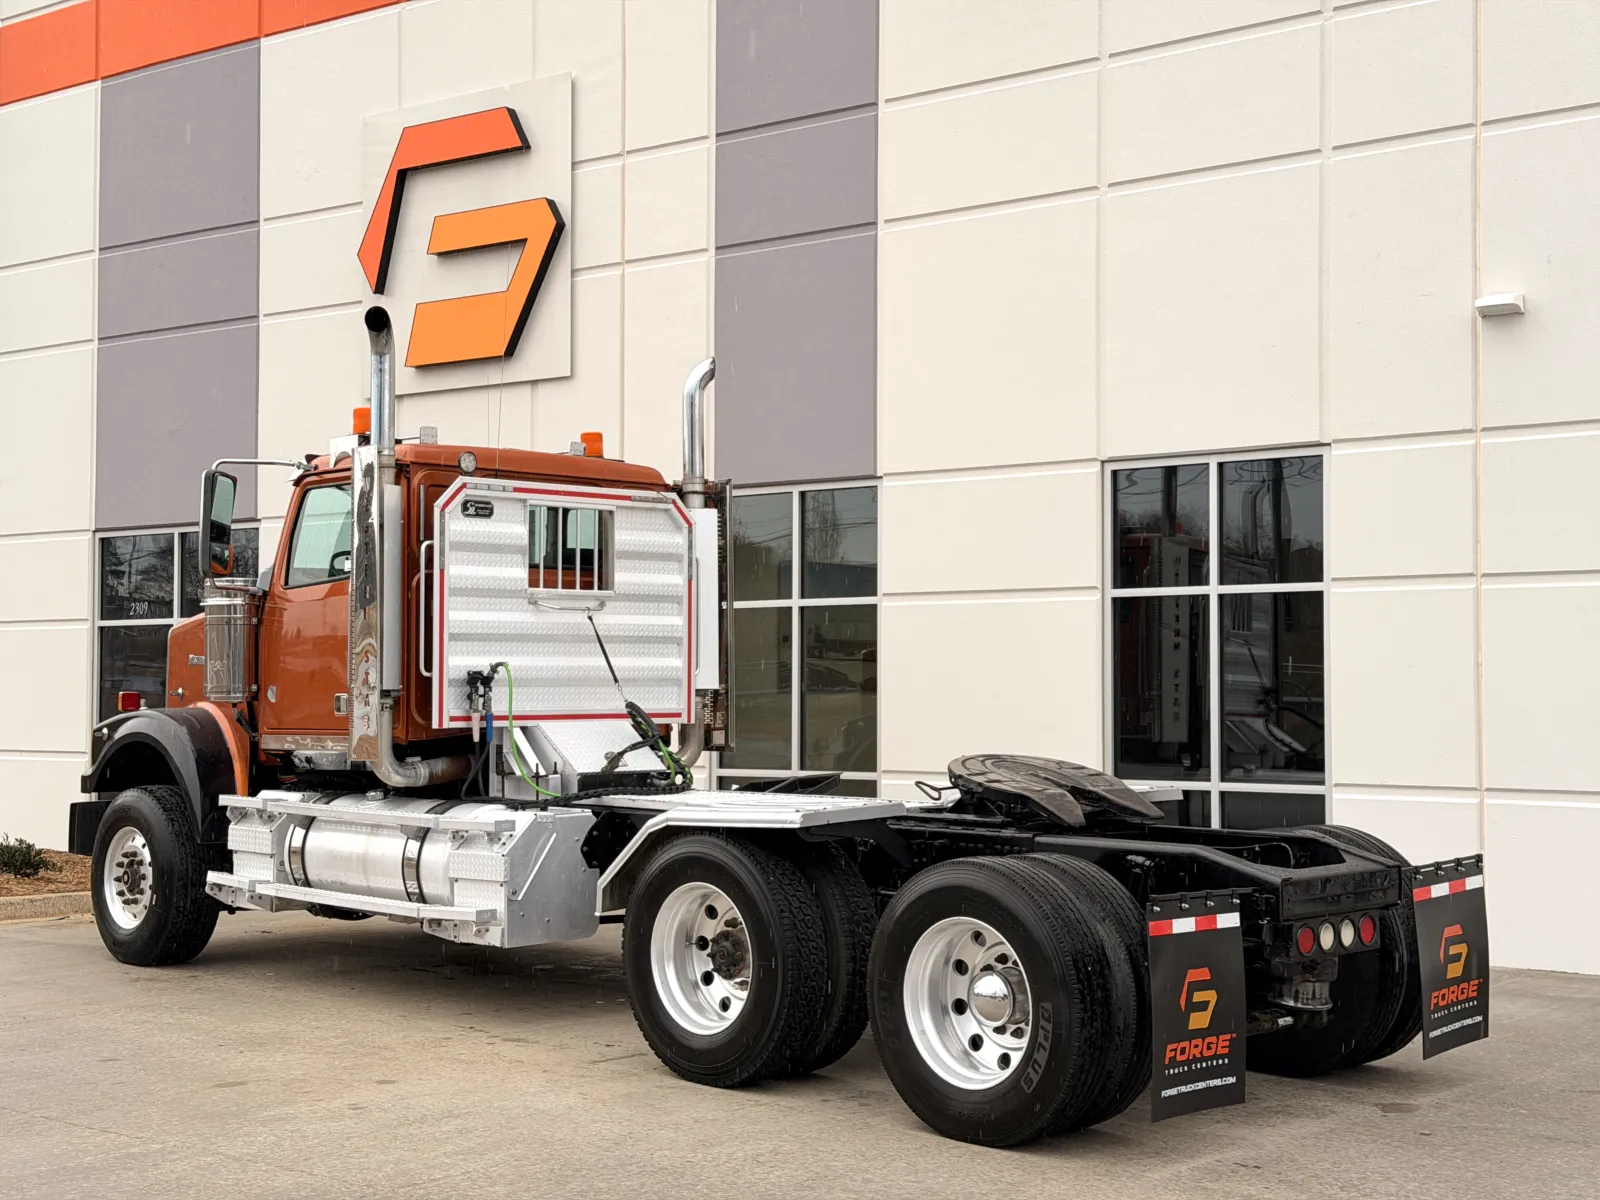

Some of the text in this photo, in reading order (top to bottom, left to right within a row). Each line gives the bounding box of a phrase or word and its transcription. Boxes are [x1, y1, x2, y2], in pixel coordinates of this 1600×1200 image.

[129, 602, 149, 616] 2309
[1430, 979, 1479, 1011] FORGE
[1164, 1033, 1231, 1065] FORGE
[1165, 1058, 1229, 1076] TRUCK CENTERS
[1161, 1076, 1237, 1098] FORGETRUCKCENTERS.COM
